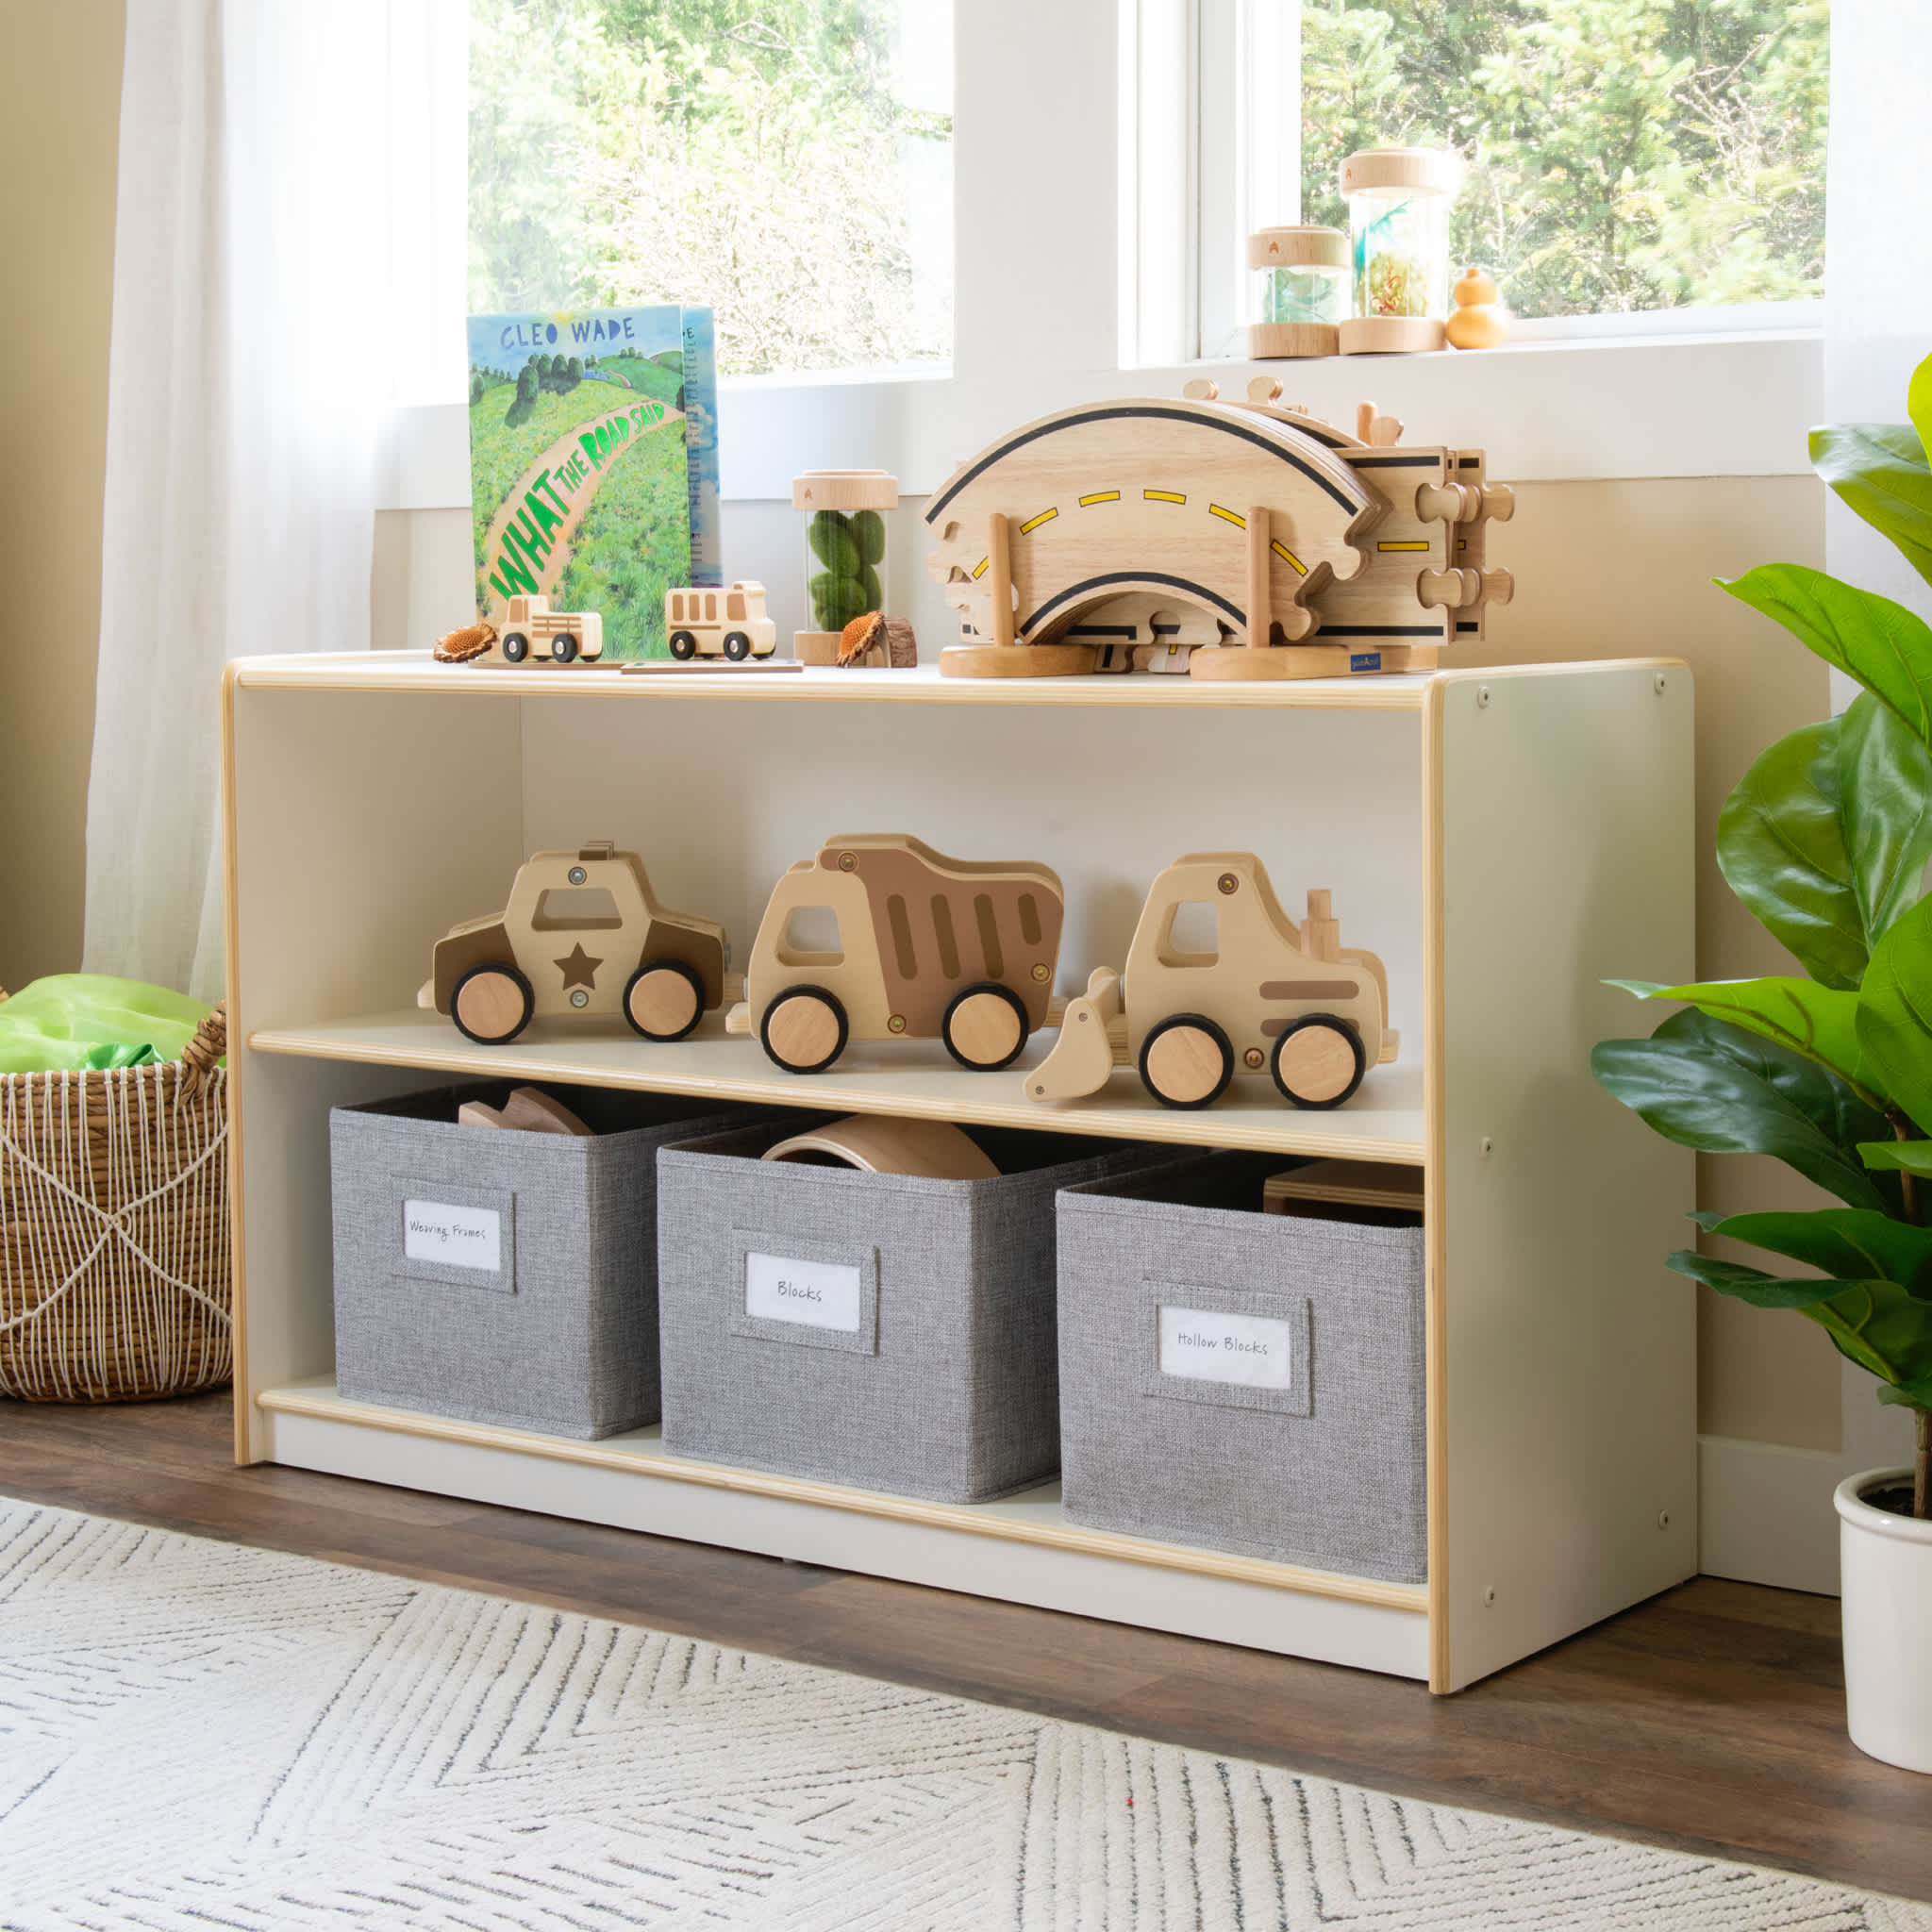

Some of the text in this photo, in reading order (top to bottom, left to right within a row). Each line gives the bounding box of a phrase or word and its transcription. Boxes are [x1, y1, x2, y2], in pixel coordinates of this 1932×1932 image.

[500, 317, 635, 349] CLEO WADE
[489, 403, 665, 601] WHAT THE ROAD SAID
[409, 1220, 486, 1242] Weaving Frames
[777, 1280, 823, 1303] Blocks
[1177, 1331, 1268, 1356] Hollow Blocks
